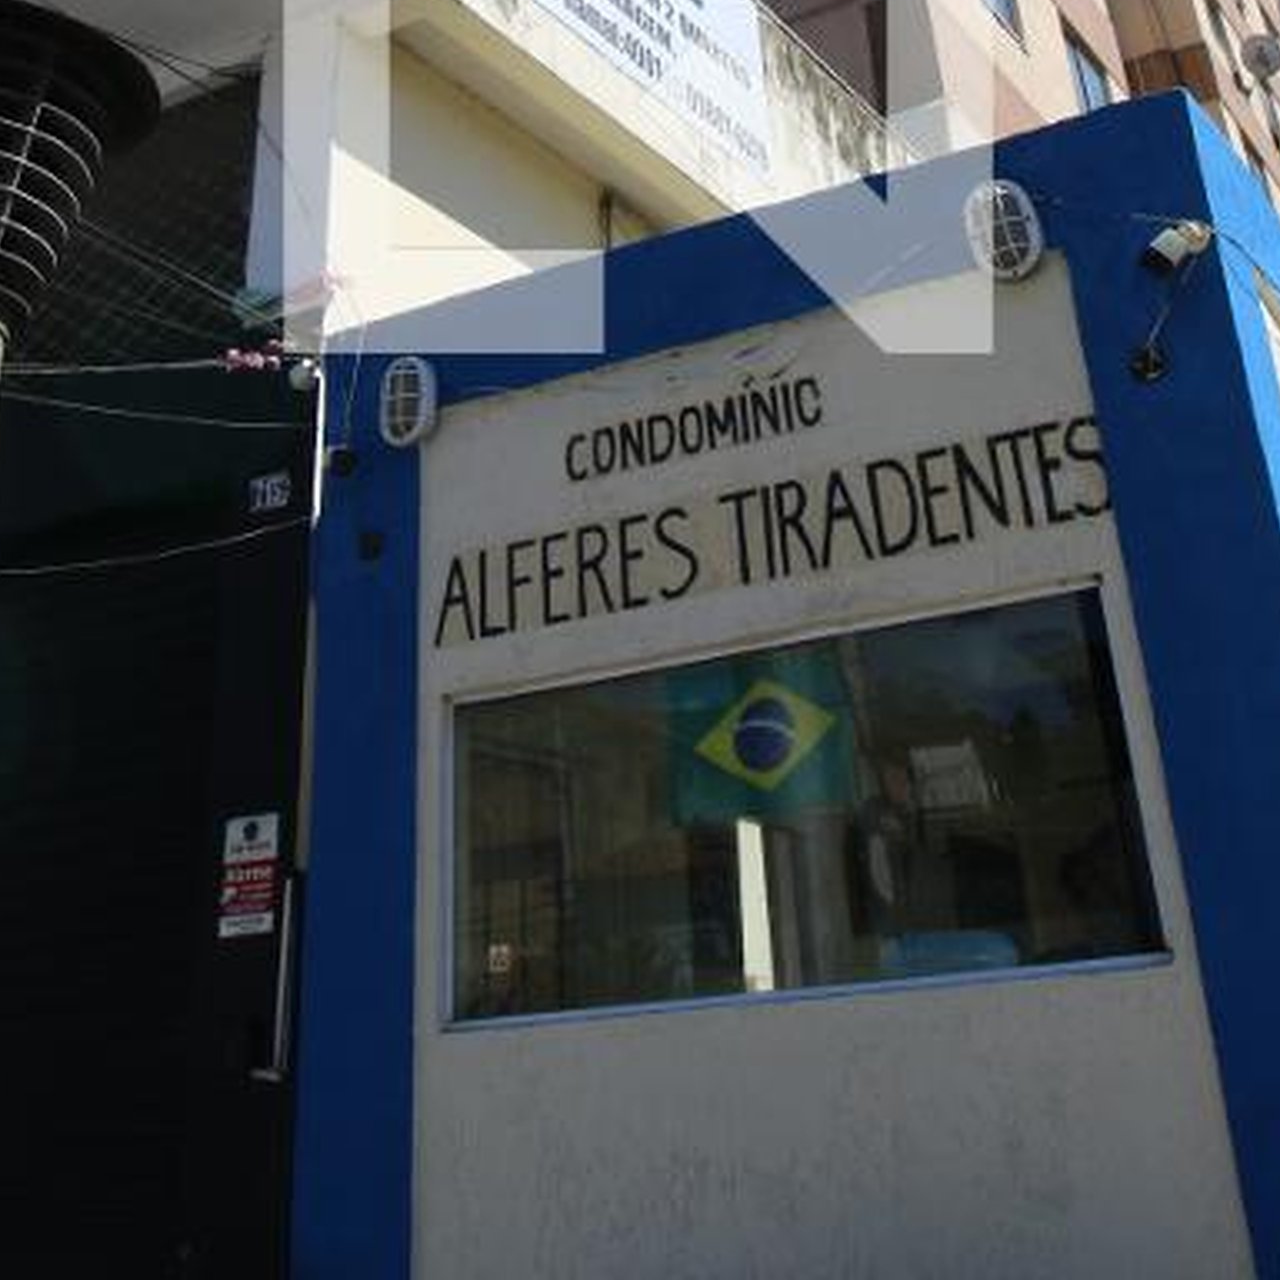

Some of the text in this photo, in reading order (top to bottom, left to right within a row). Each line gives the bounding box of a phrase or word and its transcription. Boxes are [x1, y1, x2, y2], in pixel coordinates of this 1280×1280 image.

[663, 0, 675, 20] 2
[434, 414, 1114, 649] ALFERES TIRADENTES
